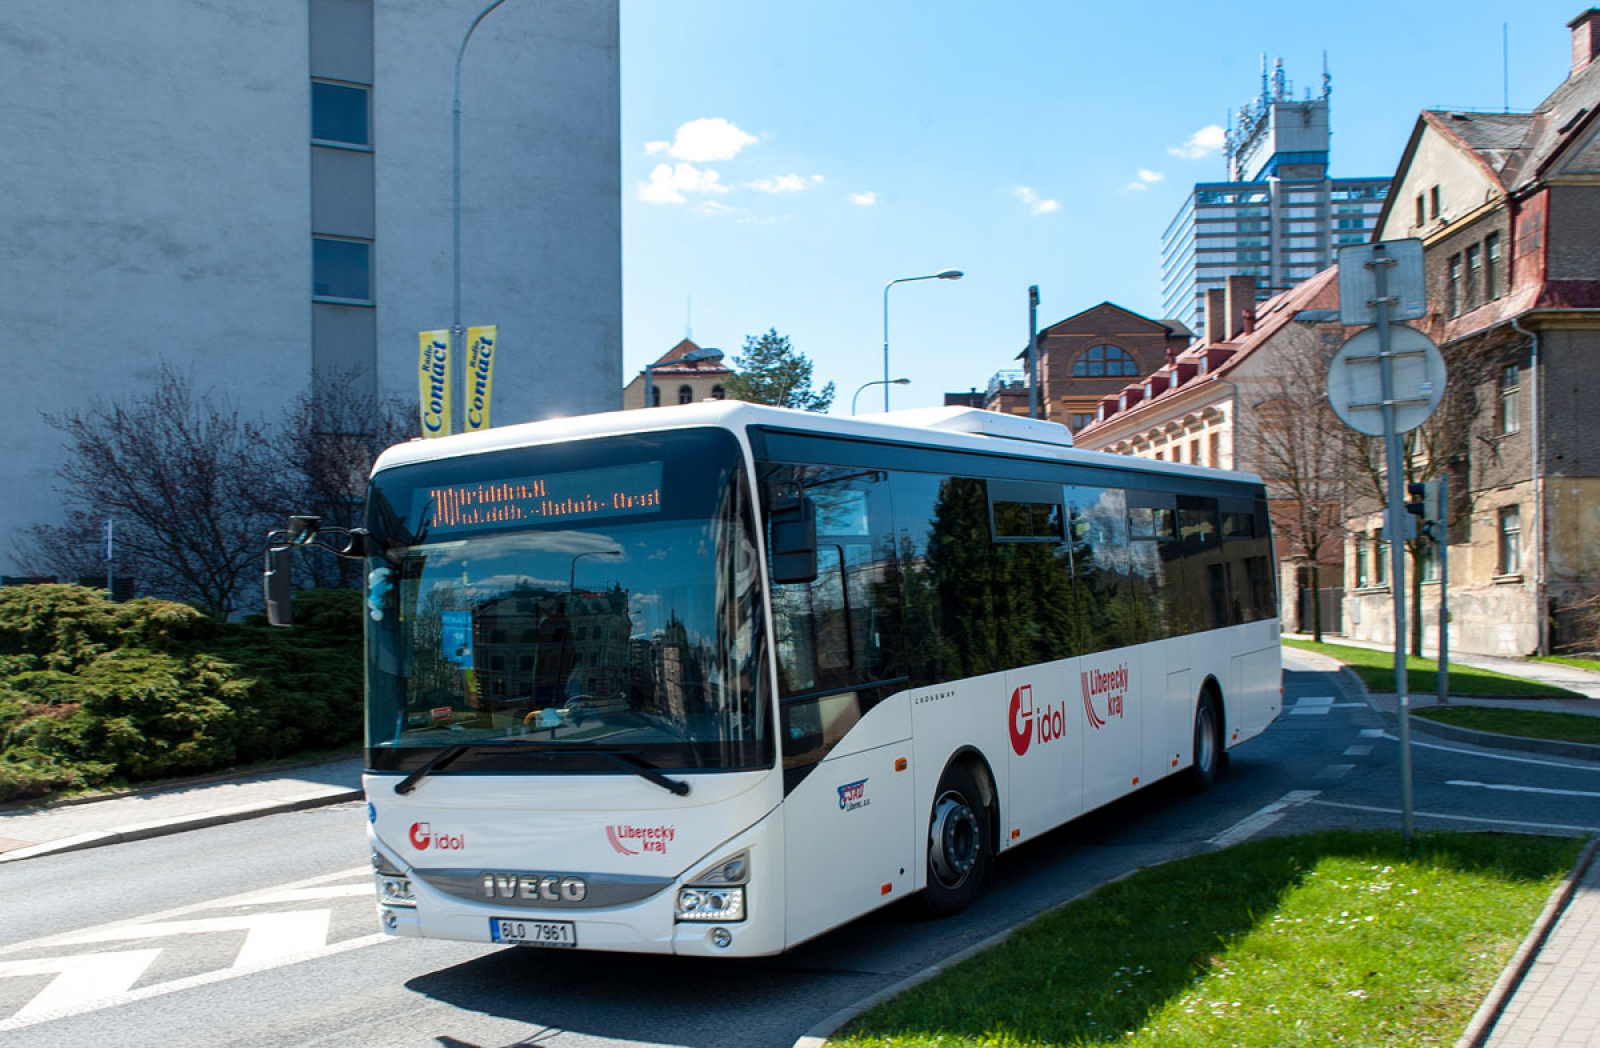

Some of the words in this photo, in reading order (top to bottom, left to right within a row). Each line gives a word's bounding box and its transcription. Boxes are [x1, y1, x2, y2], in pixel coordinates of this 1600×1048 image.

[424, 340, 447, 432] Contact
[468, 335, 493, 429] Contact
[1089, 661, 1129, 696] Liberecký
[1107, 689, 1124, 719] kraj
[1036, 700, 1066, 745] idol
[434, 832, 465, 850] idol
[618, 825, 675, 841] Liberecký
[642, 838, 667, 854] kraj
[482, 873, 587, 902] IVECO
[534, 924, 567, 941] 7961
